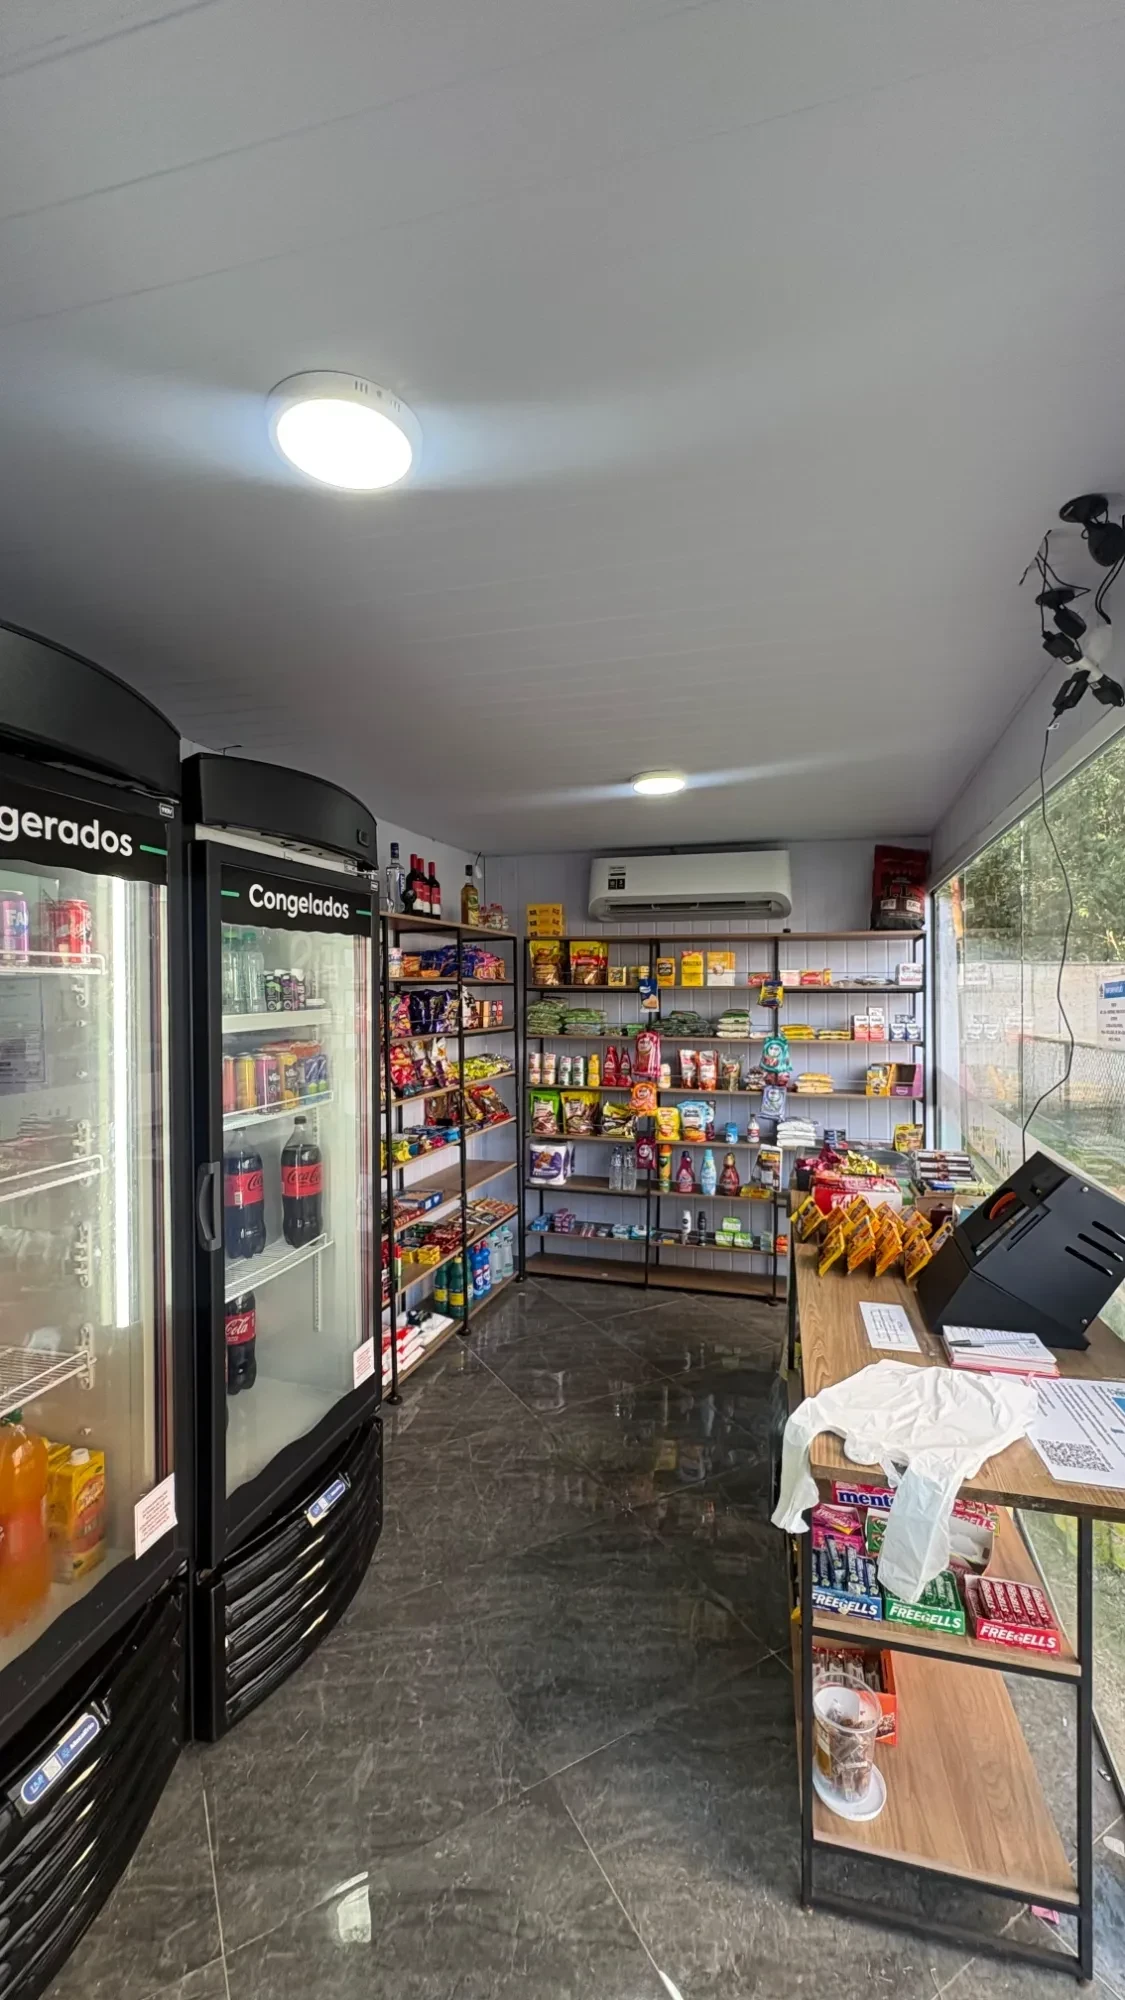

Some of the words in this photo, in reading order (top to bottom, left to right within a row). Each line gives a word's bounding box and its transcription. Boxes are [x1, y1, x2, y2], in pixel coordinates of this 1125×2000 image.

[249, 884, 350, 919] Congelados
[889, 1605, 962, 1629] FREEGELLS
[980, 1625, 1057, 1648] FREEGELLS
